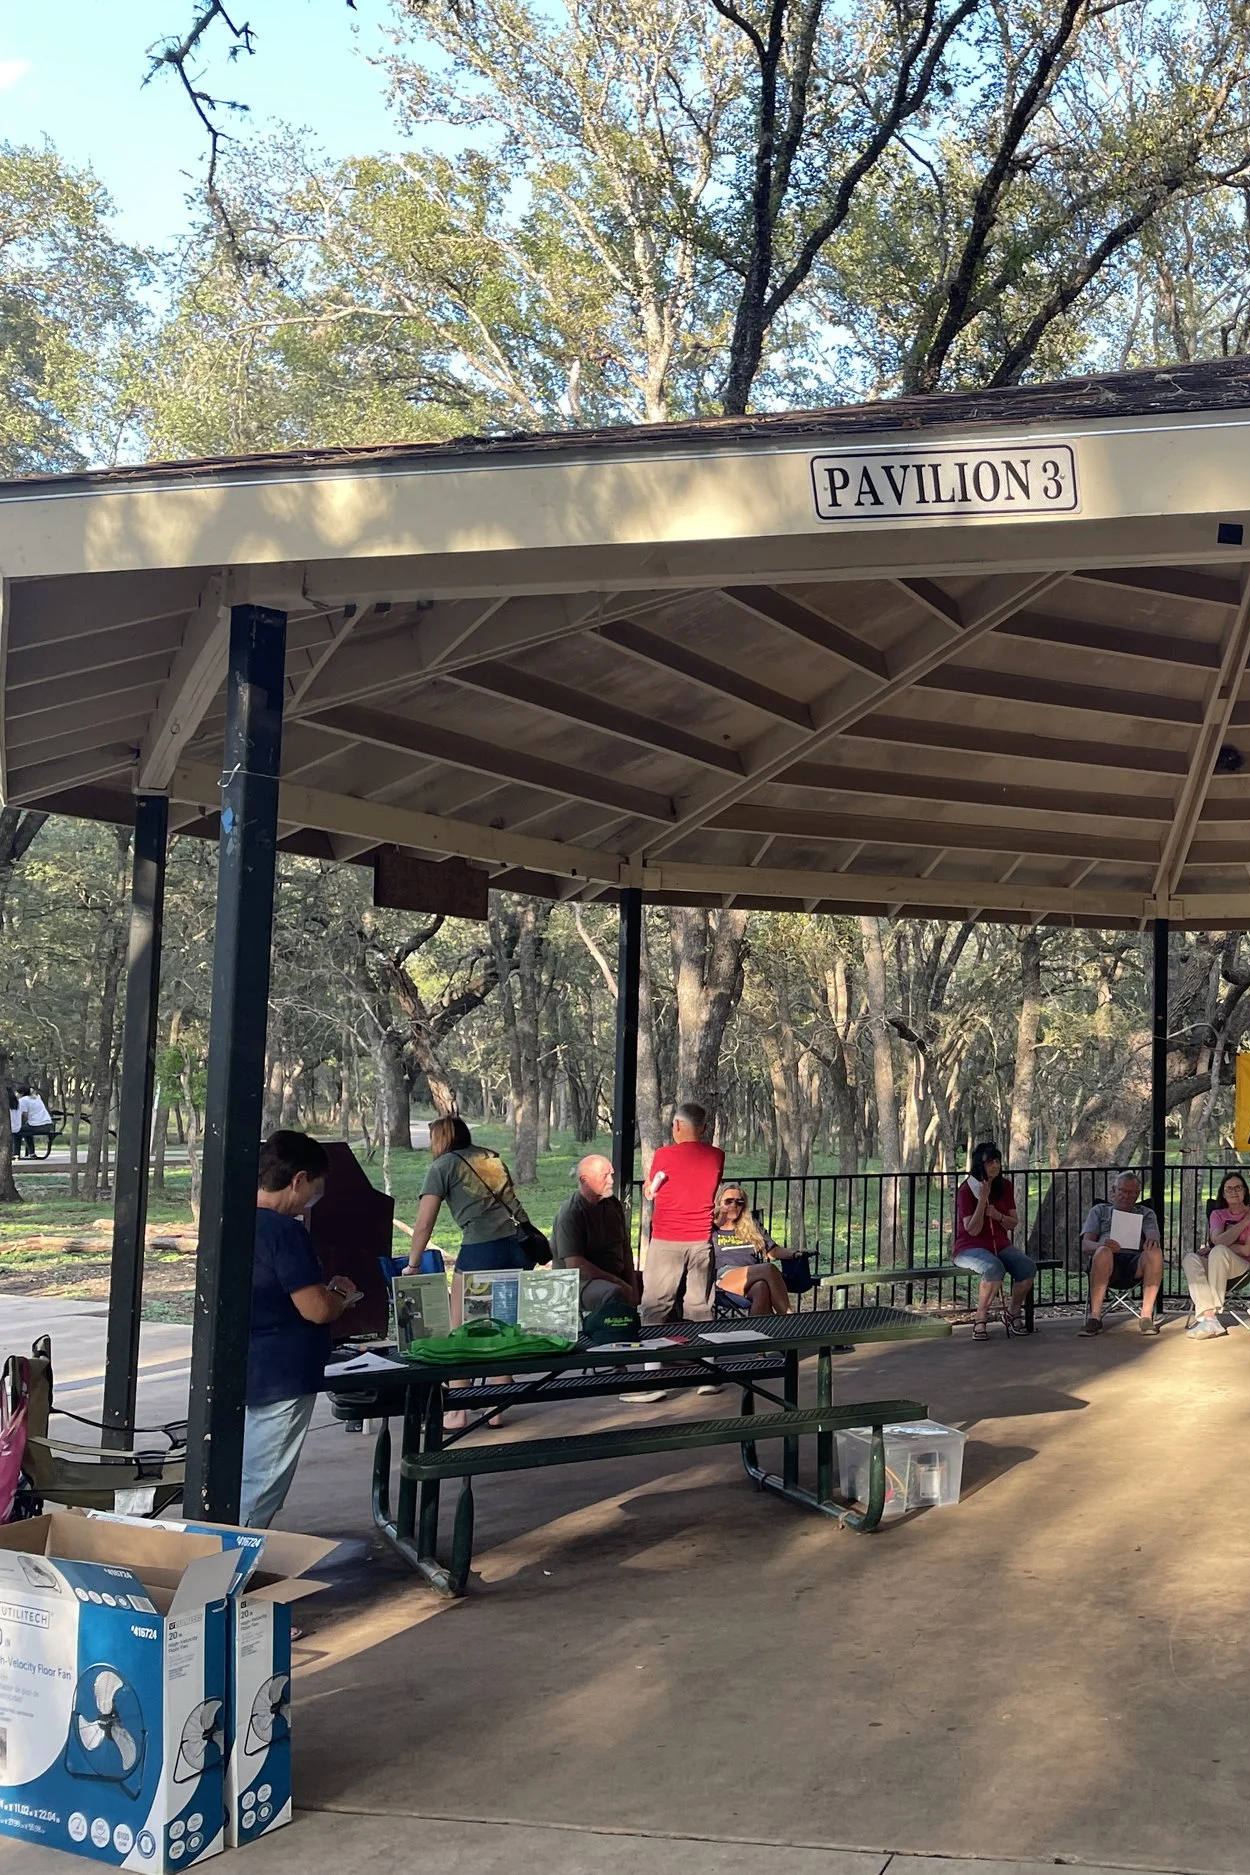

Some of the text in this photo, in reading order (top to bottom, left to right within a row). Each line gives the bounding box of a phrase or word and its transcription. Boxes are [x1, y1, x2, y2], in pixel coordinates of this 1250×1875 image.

[824, 460, 1063, 507] PAVILION 3
[2, 1607, 48, 1625] UTILITECH
[168, 1631, 178, 1641] 20
[38, 1663, 56, 1678] Floor
[58, 1667, 72, 1680] Fan
